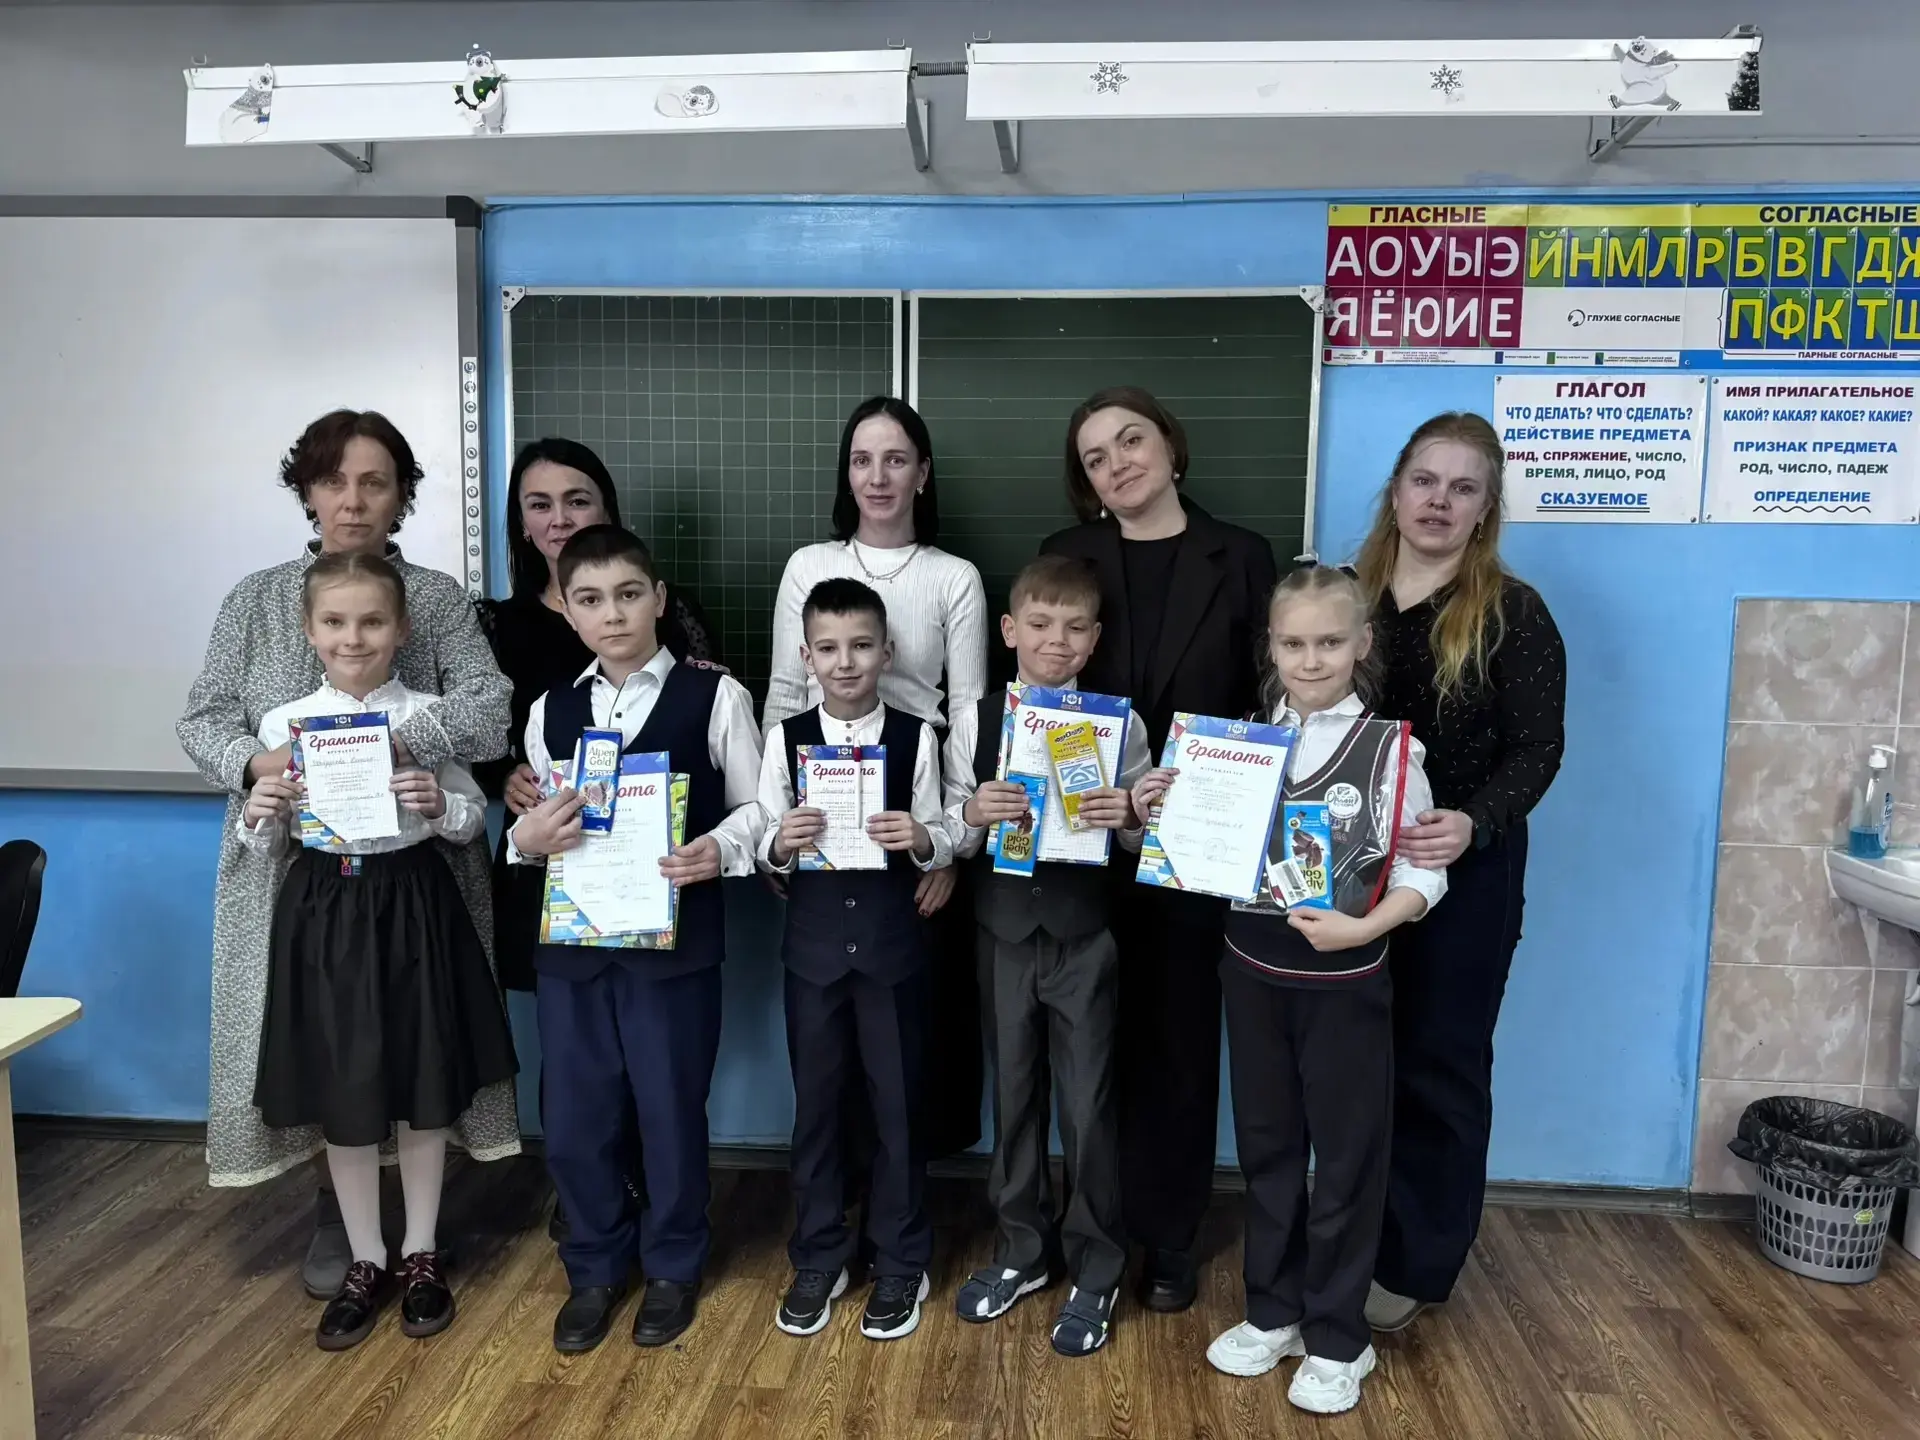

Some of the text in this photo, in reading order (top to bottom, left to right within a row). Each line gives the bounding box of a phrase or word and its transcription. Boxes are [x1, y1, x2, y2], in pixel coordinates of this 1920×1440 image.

[1369, 206, 1487, 223] ГЛАСНЫЕ
[1759, 205, 1918, 223] СОГЛАСНЫЕ
[1587, 314, 1681, 322] ГЛУХИЕ СОГЛАСНЫЕ
[1798, 351, 1898, 359] ПАРНЫЕ СОГЛАСНЫЕ
[1556, 382, 1646, 398] ГЛАГОЛ
[1726, 386, 1914, 398] ИМЯ ПРИЛАГАТЕЛЬНОЕ
[1506, 406, 1693, 422] ЧТО ДЕЛАТЬ? ЧТО СДЕЛАТЬ?
[1723, 407, 1913, 422] КАКОЙ? КАКАЯ? КАКОЕ? КАКИЕ?
[1503, 426, 1692, 442] ДЕЙСТВИЕ ПРЕДМЕТА
[1733, 441, 1897, 454] ПРИЗНАК ПРЕДМЕТА
[1507, 451, 1687, 463] ВИД, СПРЯЖЕНИЕ, ЧИСЛО,
[1525, 468, 1666, 481] ВРЕМЯ, ЛИЦО, РОД
[1739, 463, 1889, 475] РОД, ЧИСЛО, ПАДЕЖ
[1540, 492, 1648, 505] СКАЗУЕМОЕ
[1754, 490, 1871, 504] ОПРЕДЕЛЕНИЕ
[309, 734, 382, 753] Грамота
[588, 746, 615, 758] Alpen
[1186, 739, 1274, 766] Грамота
[589, 757, 612, 767] Gold
[1006, 834, 1030, 846] Gold
[1003, 843, 1031, 856] Alpen
[1301, 869, 1322, 880] Gol
[1306, 877, 1325, 890] Alp
